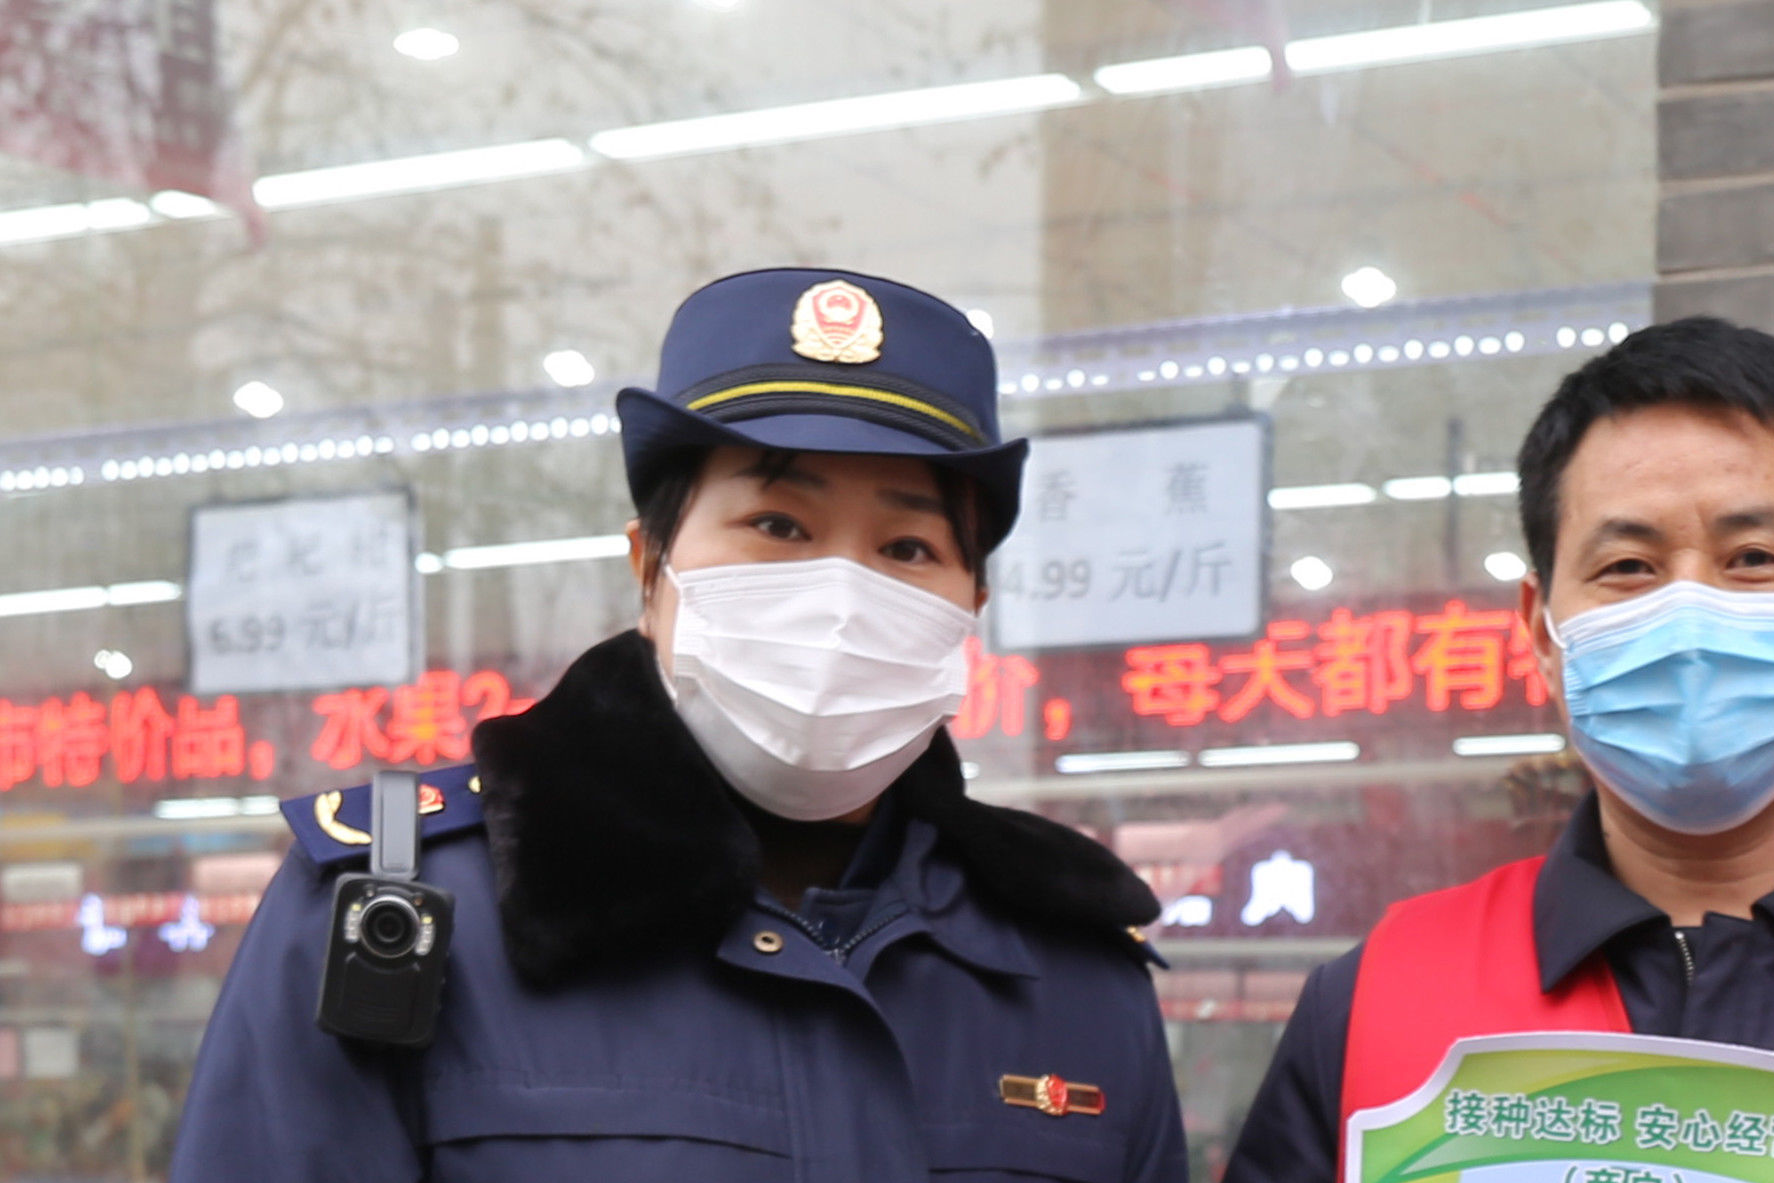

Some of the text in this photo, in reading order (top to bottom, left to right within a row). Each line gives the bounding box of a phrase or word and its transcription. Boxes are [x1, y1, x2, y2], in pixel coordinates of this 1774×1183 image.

[1107, 540, 1233, 602] 元/斤
[1445, 1090, 1620, 1142] 接种达标
